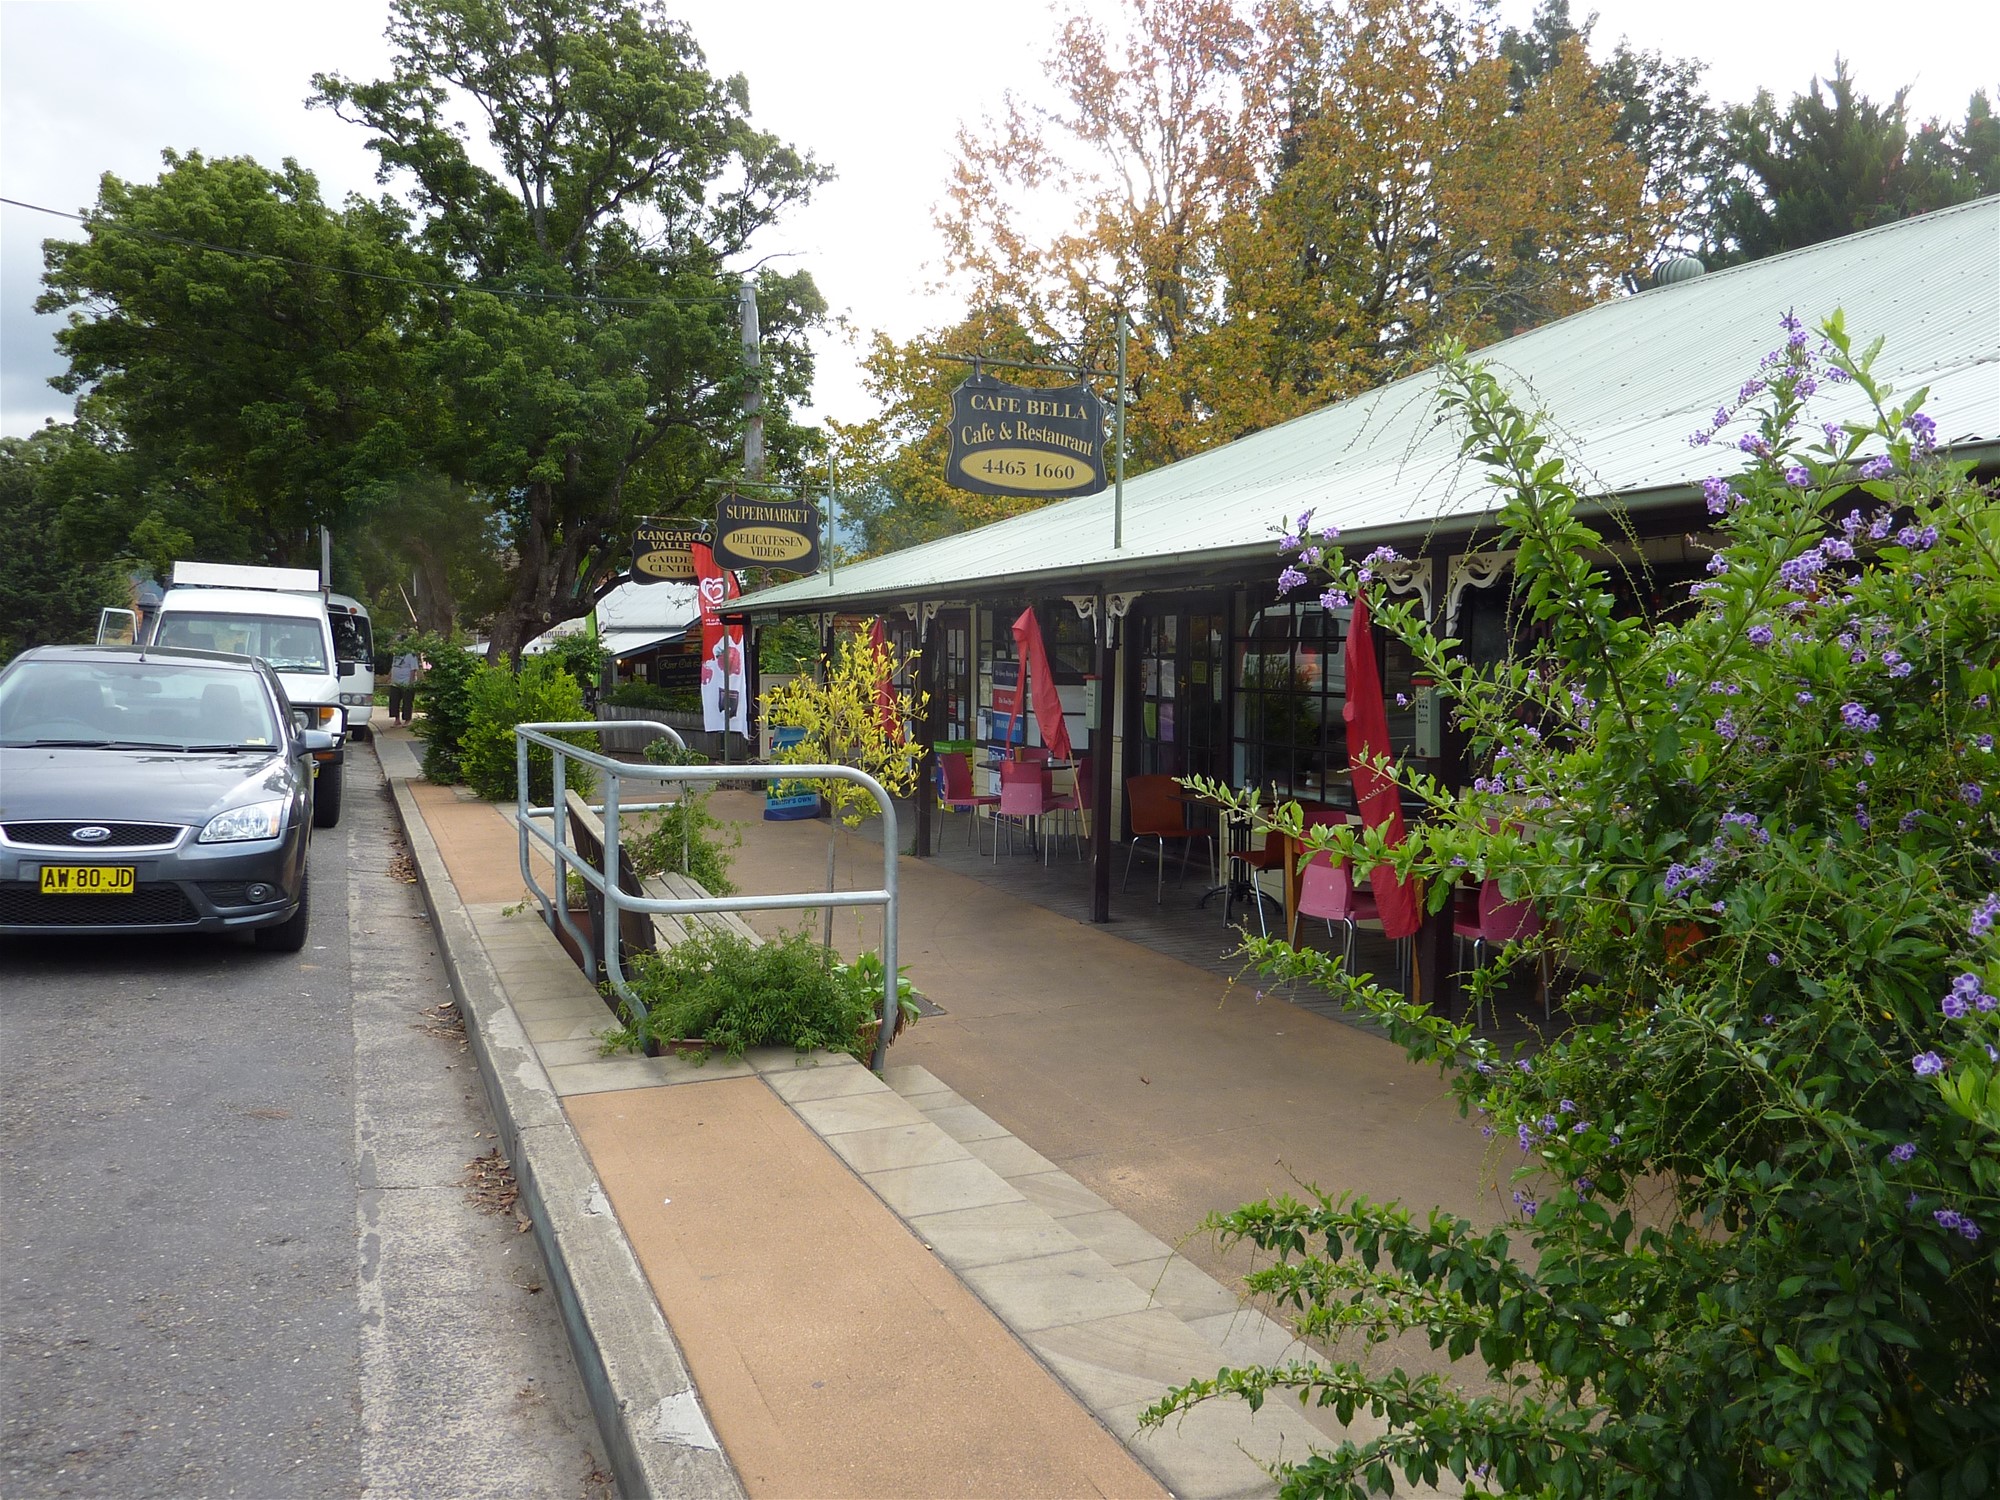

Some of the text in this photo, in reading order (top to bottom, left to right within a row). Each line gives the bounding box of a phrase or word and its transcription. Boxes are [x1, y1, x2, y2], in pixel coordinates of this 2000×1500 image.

[970, 394, 1088, 420] CAFE BELLA
[961, 420, 1093, 457] Cafe & Restaurant
[982, 459, 1075, 480] 4465 1660
[726, 504, 810, 524] SUPERMARKET
[637, 530, 712, 543] KANGAROO
[732, 532, 803, 547] DELICATESSEN
[651, 541, 691, 551] VALLE
[750, 545, 786, 557] VIDEOS
[647, 554, 695, 563] GARDE
[44, 869, 133, 888] AW 80 JD
